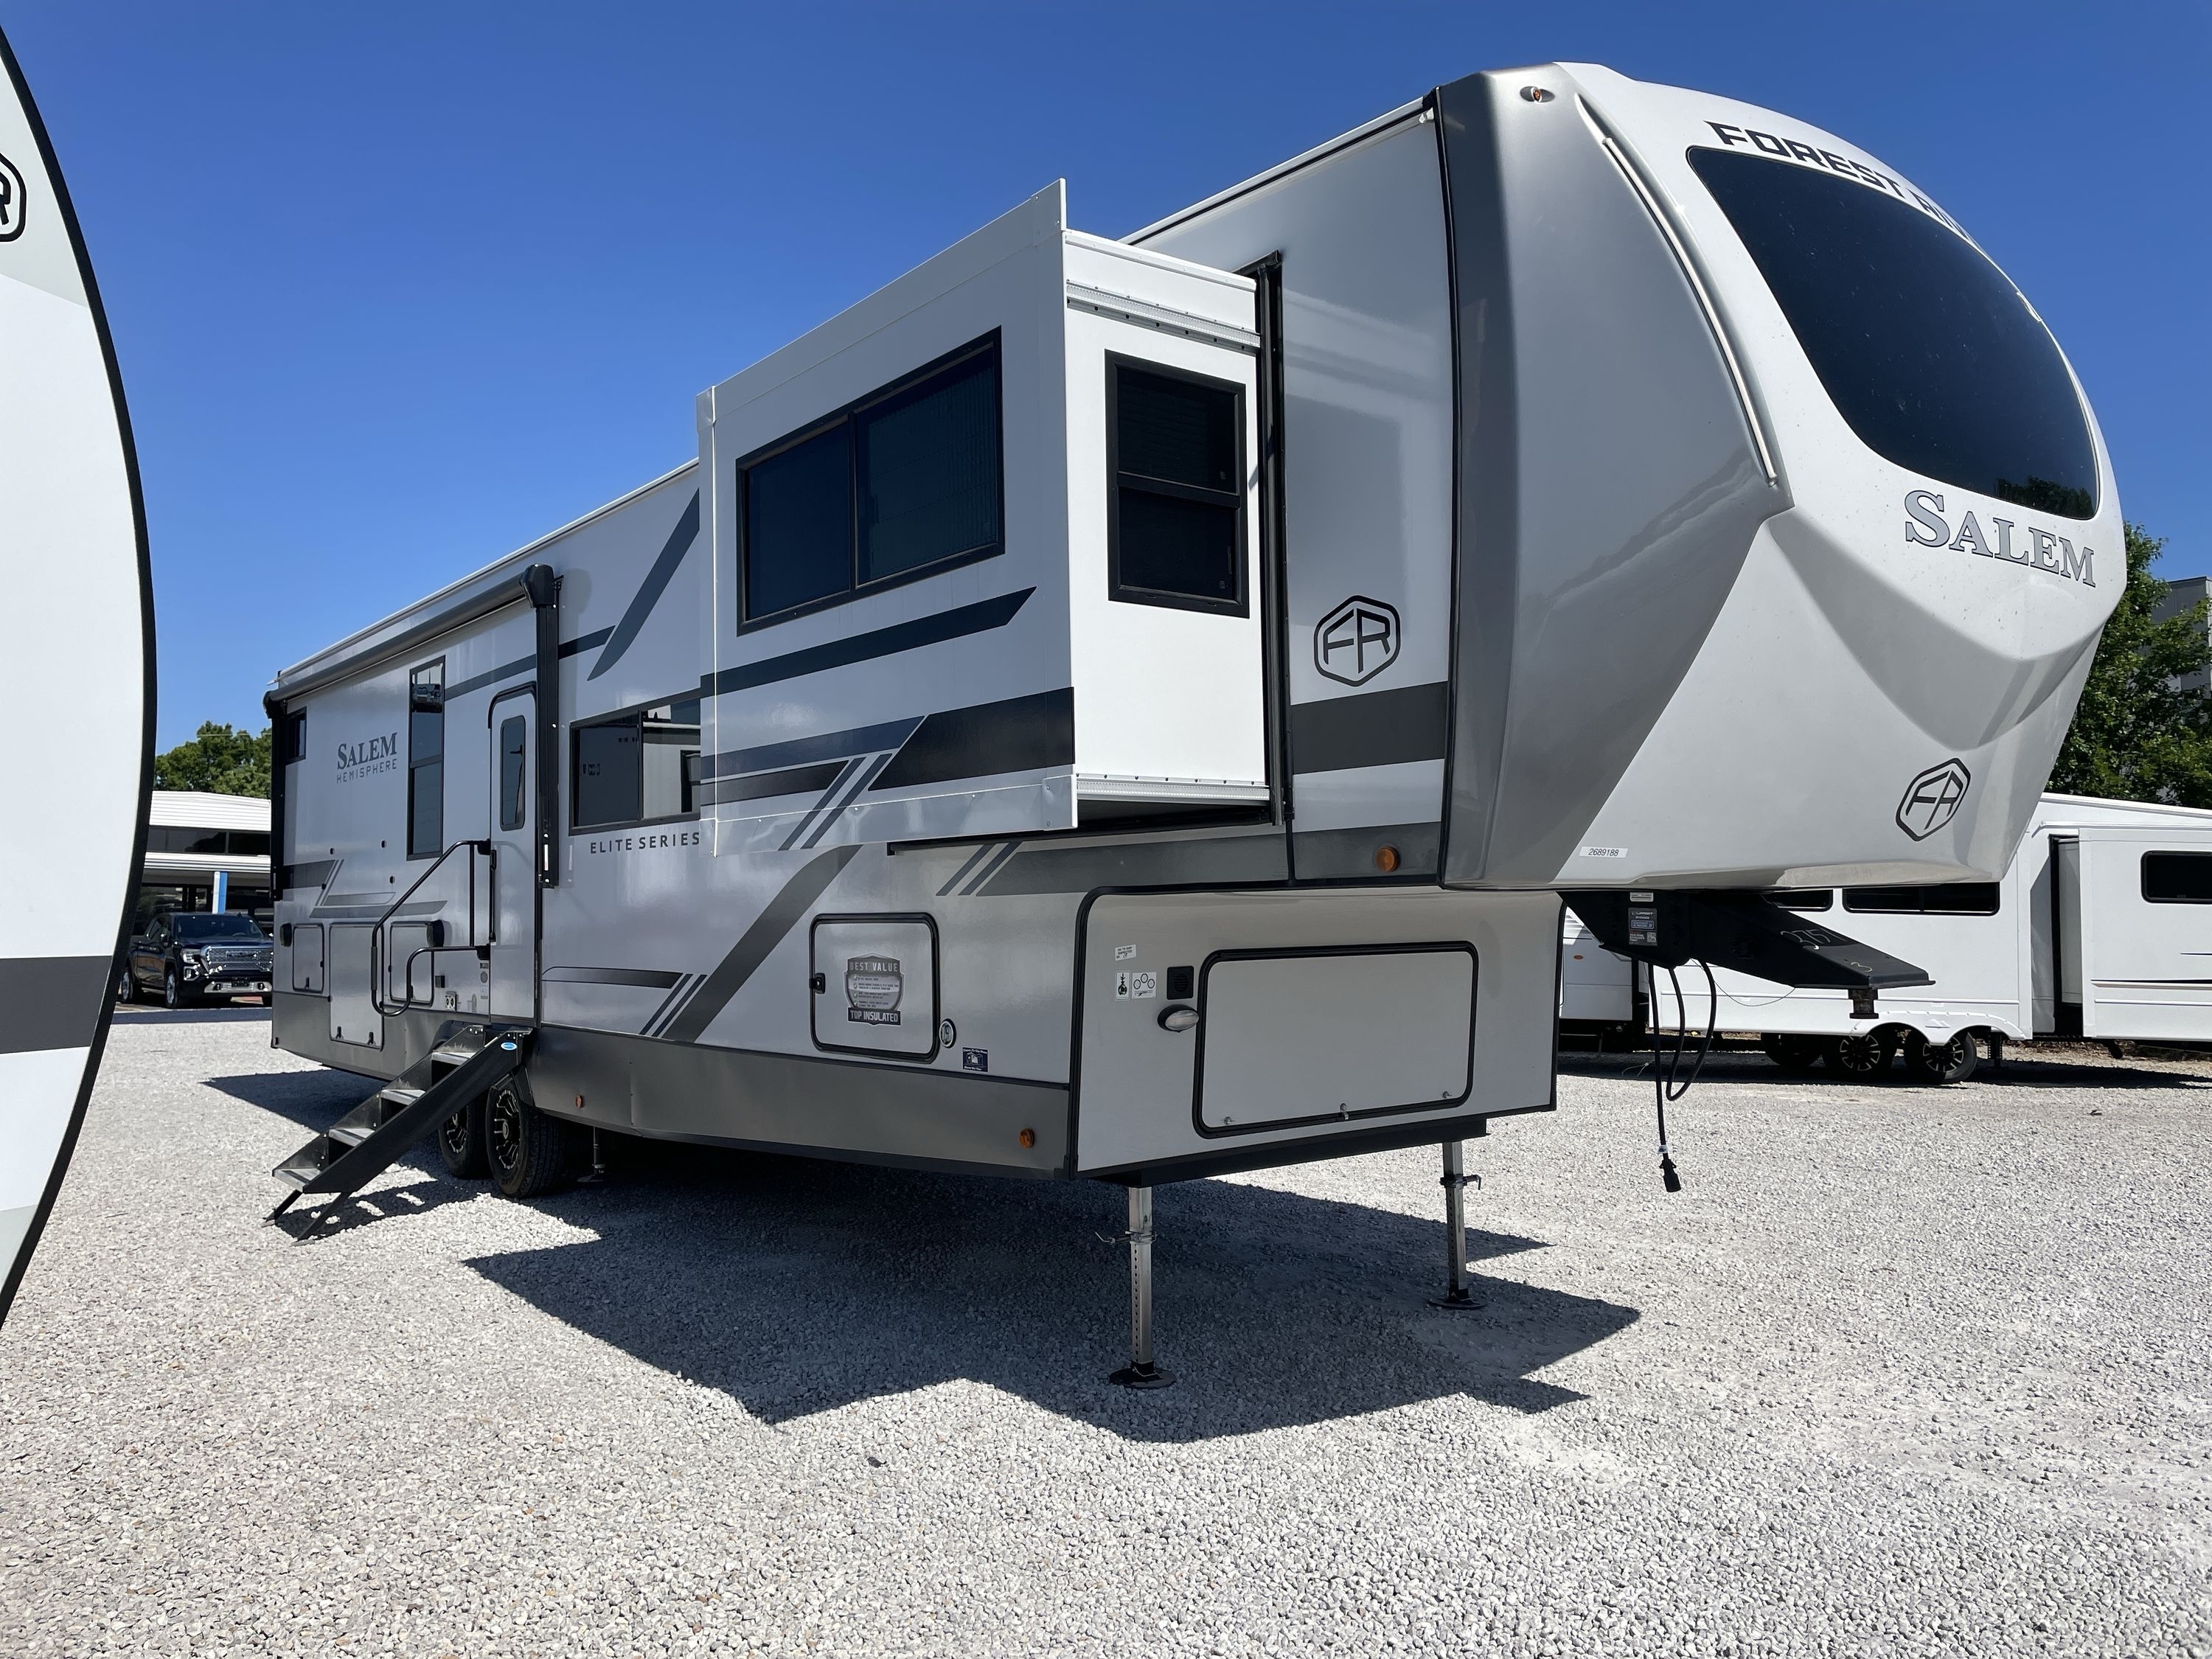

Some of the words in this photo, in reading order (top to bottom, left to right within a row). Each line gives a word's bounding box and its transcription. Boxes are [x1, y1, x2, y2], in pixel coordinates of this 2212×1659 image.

[1703, 120, 1905, 199] FOREST
[1905, 490, 2096, 588] SALEM
[337, 732, 397, 770] SALEM
[336, 758, 397, 784] HEMISPHERE
[591, 838, 632, 854] ELITE
[639, 832, 700, 849] SERIES
[1588, 848, 1619, 857] 2689188
[849, 961, 869, 971] BEST
[872, 962, 898, 972] VALUE
[850, 1010, 862, 1019] TOP
[863, 1011, 898, 1023] INSULATED
